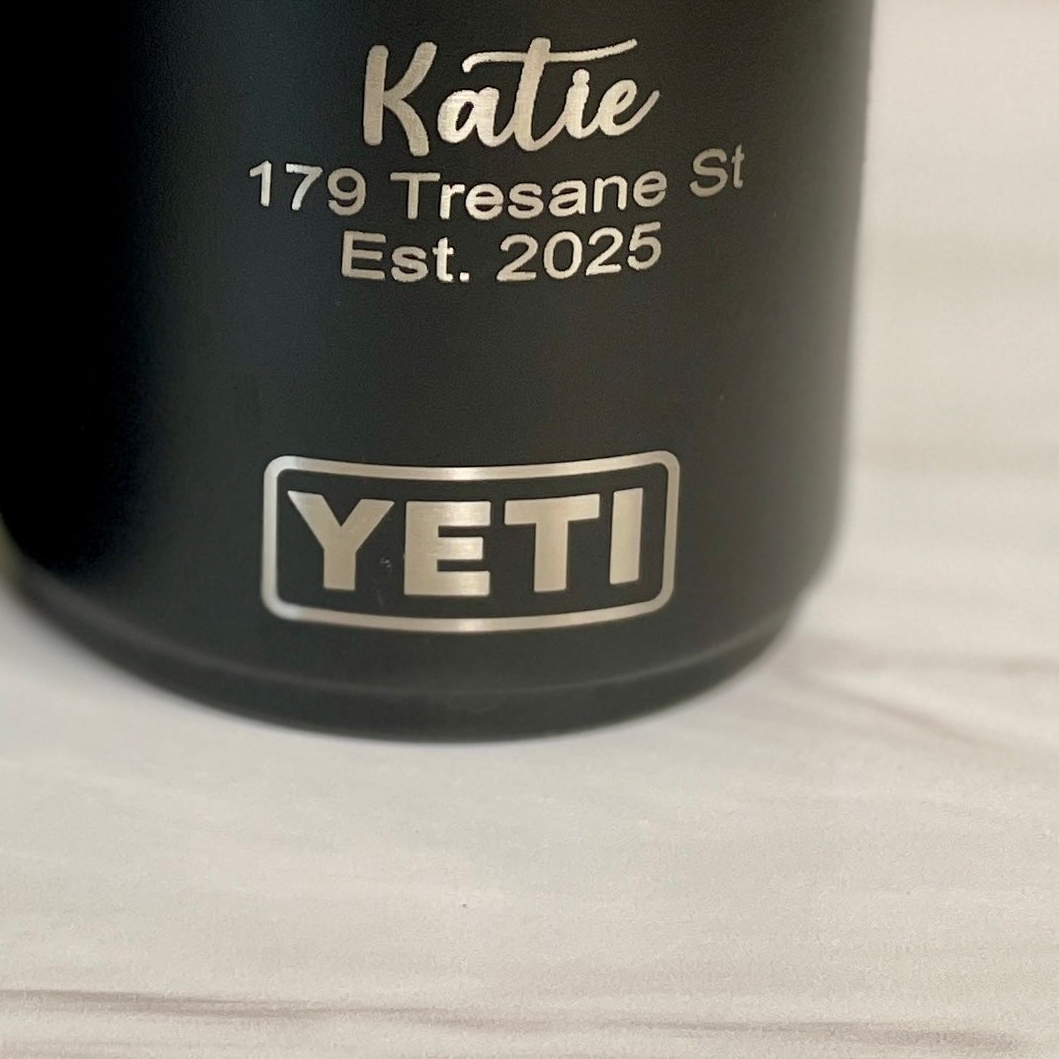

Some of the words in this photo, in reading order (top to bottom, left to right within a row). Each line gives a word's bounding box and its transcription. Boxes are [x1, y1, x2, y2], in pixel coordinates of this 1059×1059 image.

[362, 36, 660, 158] Katie
[248, 159, 367, 217] 179
[389, 169, 669, 221] Tresane
[688, 144, 746, 198] St
[340, 229, 471, 284] Est.
[495, 220, 663, 283] 2025
[286, 486, 645, 599] YETI
